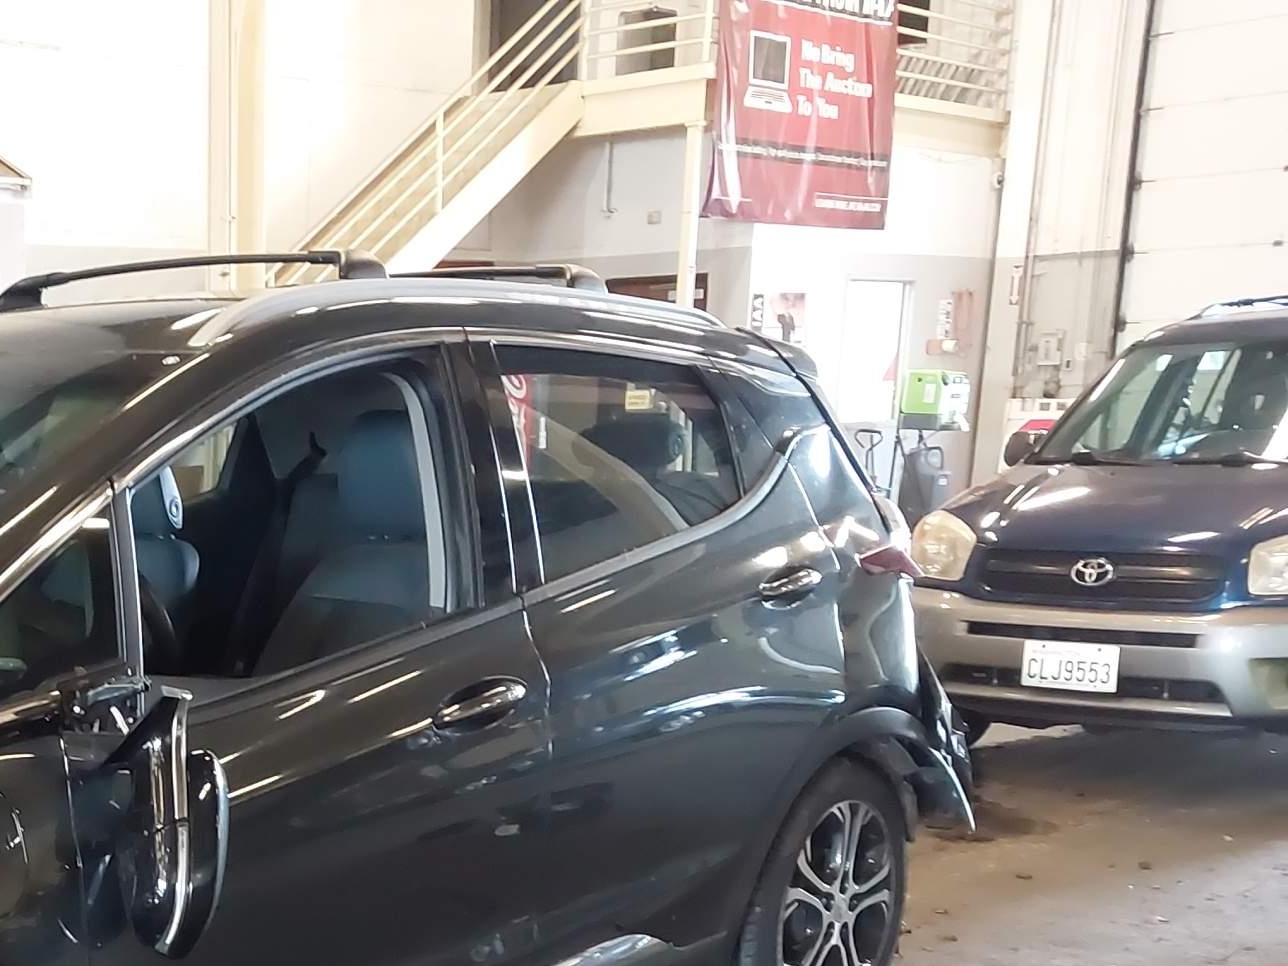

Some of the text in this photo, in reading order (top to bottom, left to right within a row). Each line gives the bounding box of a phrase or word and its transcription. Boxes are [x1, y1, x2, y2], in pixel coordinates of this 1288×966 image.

[821, 43, 855, 73] Bring
[799, 67, 873, 98] The Auction
[796, 94, 839, 120] To You
[1027, 657, 1111, 685] CLJ9553
